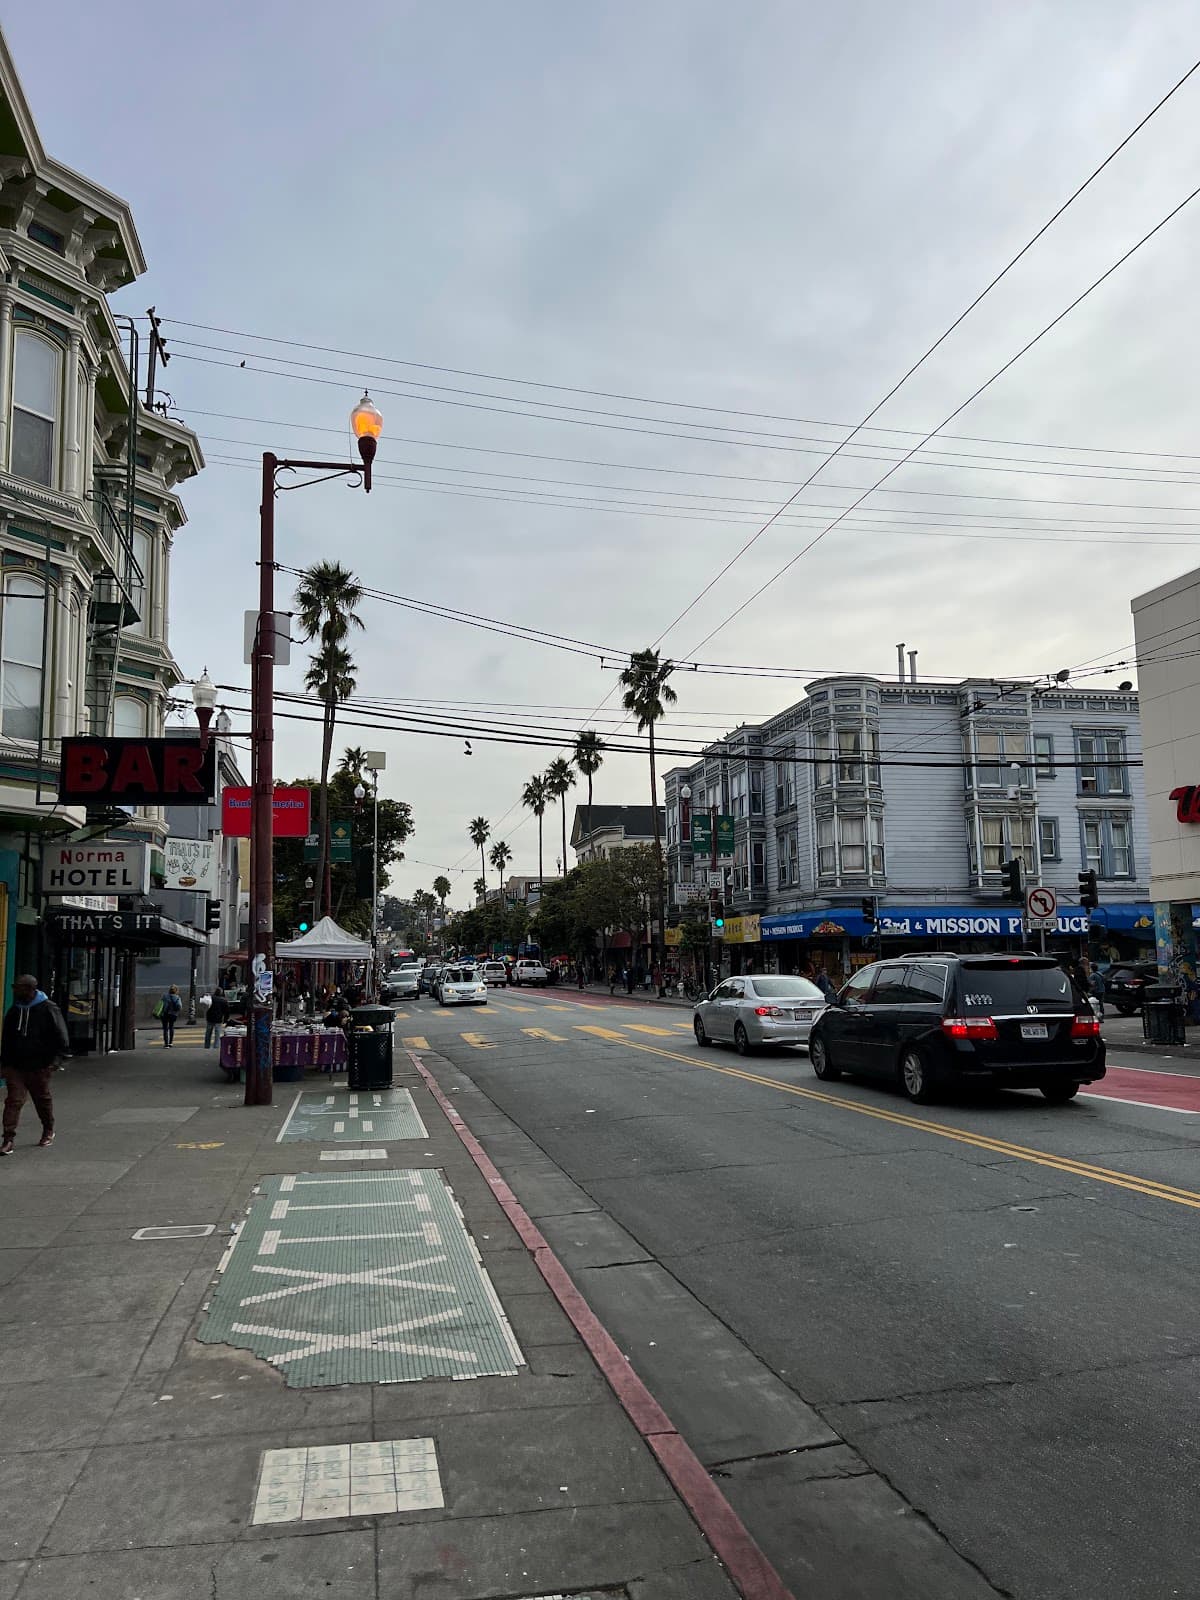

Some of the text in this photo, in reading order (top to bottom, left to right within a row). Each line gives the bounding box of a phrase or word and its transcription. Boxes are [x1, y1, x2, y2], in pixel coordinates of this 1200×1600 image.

[65, 744, 205, 793] BAR
[60, 850, 125, 865] Norma
[168, 841, 212, 858] THAT'S IT
[51, 869, 133, 886] HOTEL
[925, 918, 1000, 934] MISSION
[1008, 917, 1089, 934] PUCE
